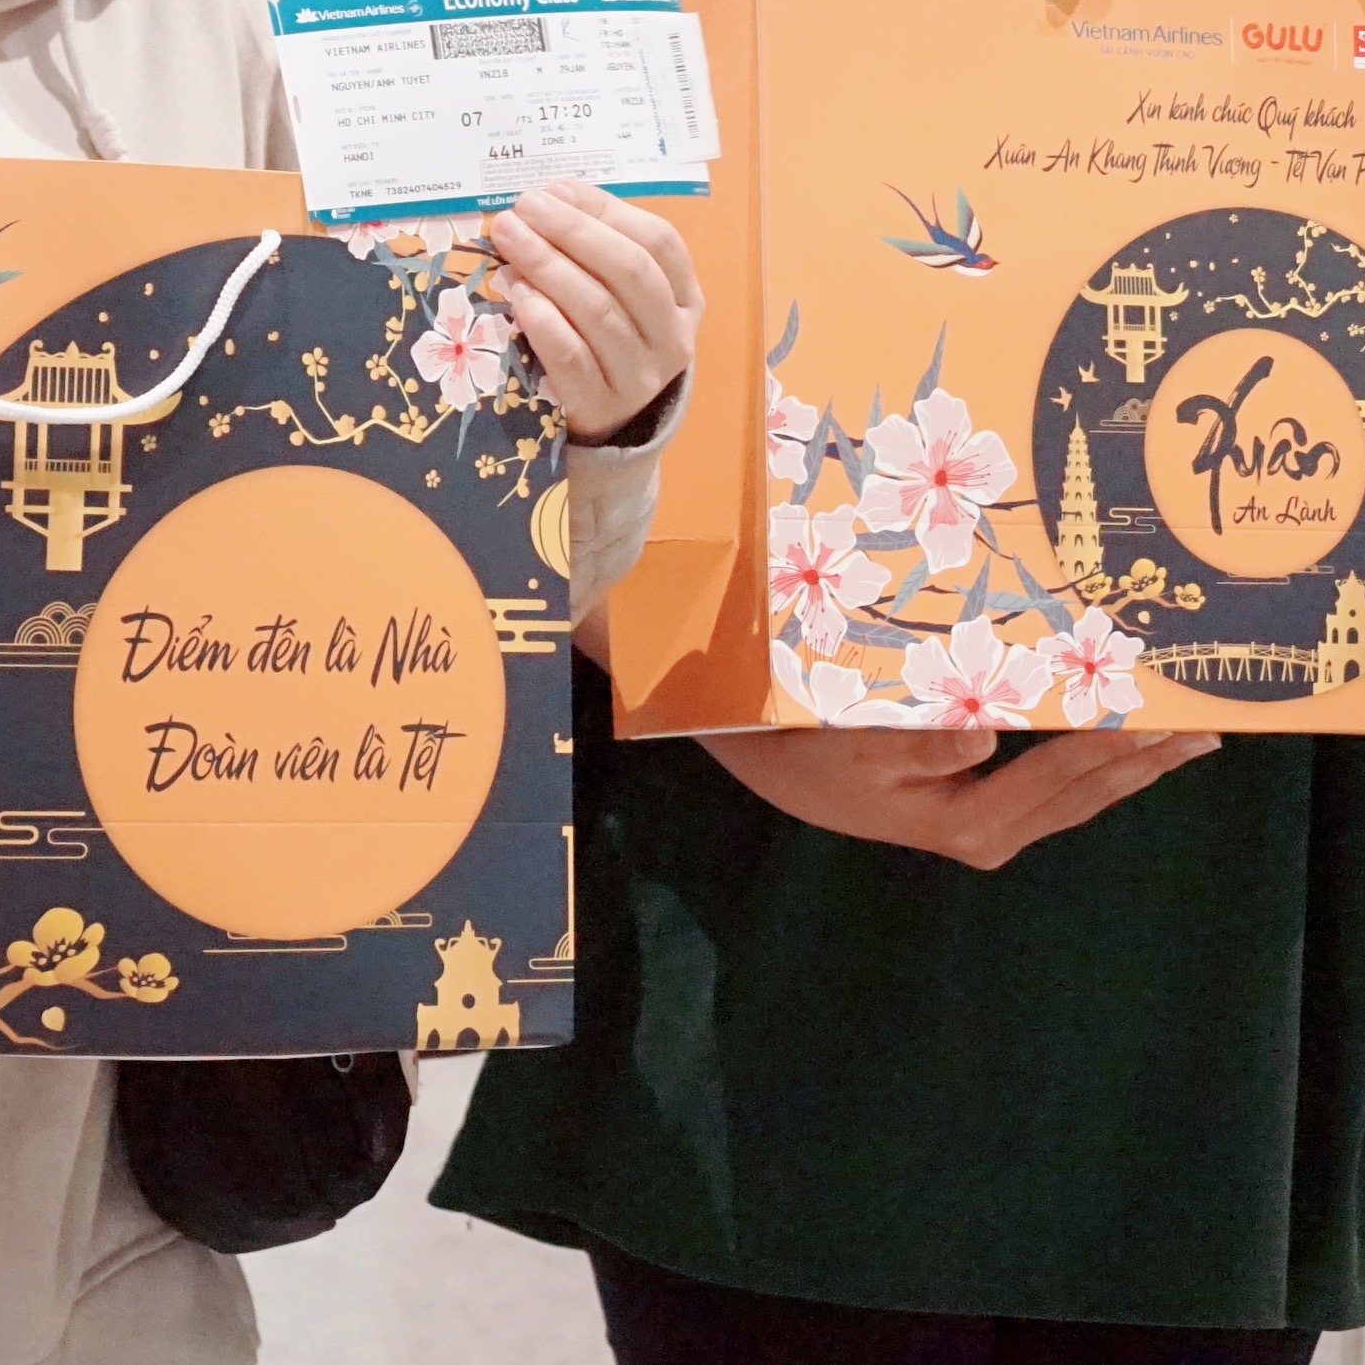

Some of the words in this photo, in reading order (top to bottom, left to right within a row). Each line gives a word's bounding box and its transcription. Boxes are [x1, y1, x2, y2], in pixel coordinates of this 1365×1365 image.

[1242, 23, 1323, 53] GULU
[325, 43, 371, 57] VIETNAM
[377, 39, 426, 52] AIRLINES
[479, 69, 508, 79] VN218
[560, 65, 585, 74] 29JAN
[331, 78, 395, 92] NGUYEN/ANH
[401, 75, 431, 85] TUYET
[357, 116, 376, 126] CHI
[382, 113, 406, 124] MINH
[412, 110, 436, 121] CITY
[461, 111, 483, 127] 07
[538, 103, 592, 121] 17:20
[1127, 89, 1161, 124] Xin
[1169, 92, 1207, 123] kính
[1212, 94, 1253, 124] chúc
[1257, 96, 1299, 141] Quý
[1303, 98, 1358, 129] khách
[542, 137, 565, 145] ZONE
[344, 152, 374, 163] HANOI
[489, 144, 523, 159] 44H
[984, 134, 1036, 170] Xuân
[1042, 138, 1080, 173] An
[1087, 137, 1148, 184] Khang
[1202, 143, 1262, 188] Vượng
[1285, 148, 1317, 184] Tết
[349, 190, 373, 199] TKNE
[1176, 355, 1342, 536] Xuân
[1233, 494, 1270, 523] An
[1276, 496, 1338, 525] Lành
[120, 604, 240, 684] Điểm
[247, 609, 312, 675] đến
[325, 615, 363, 673] là
[371, 606, 458, 689] Nhà
[144, 714, 260, 794] Đoàn
[274, 736, 340, 783] viên
[353, 723, 392, 782] là
[399, 717, 468, 793] Tết
